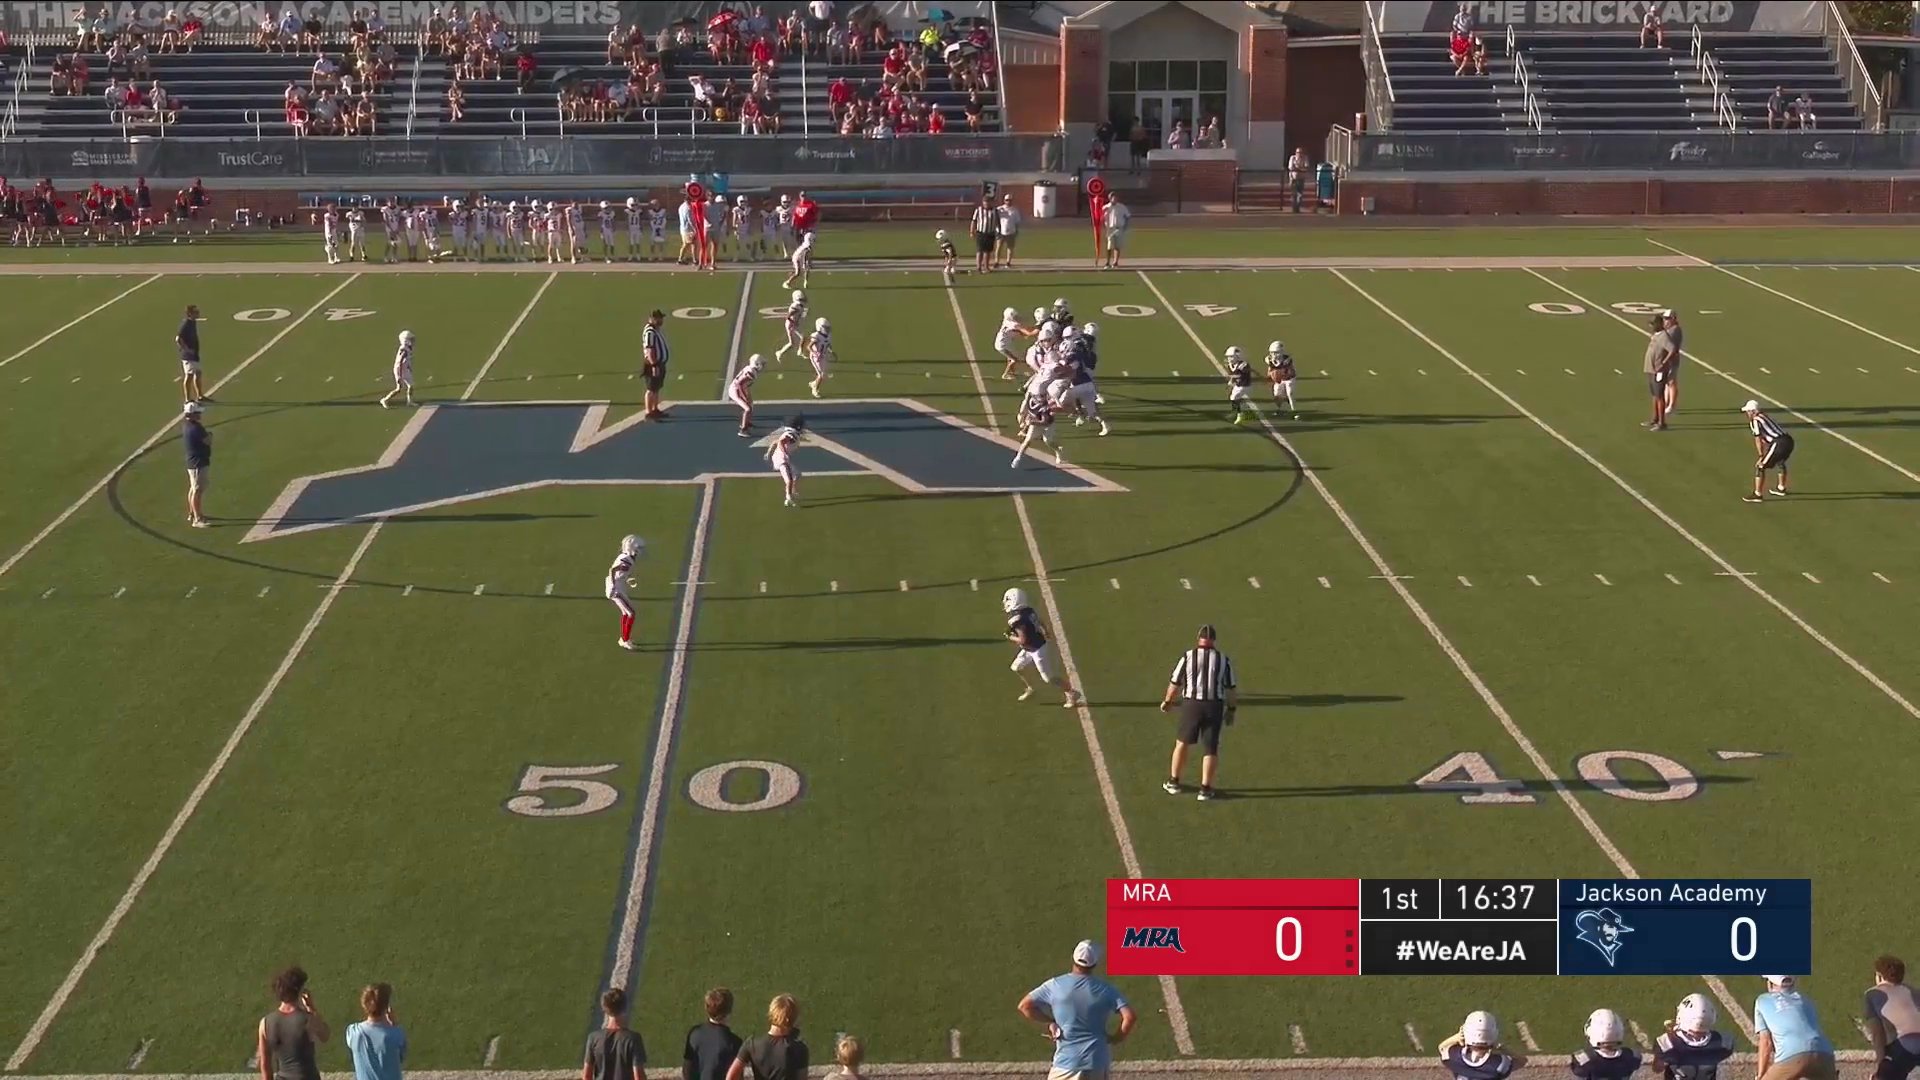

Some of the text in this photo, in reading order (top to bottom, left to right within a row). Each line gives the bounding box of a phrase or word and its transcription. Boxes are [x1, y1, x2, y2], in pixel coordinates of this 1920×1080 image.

[13, 1, 84, 28] THE
[1465, 1, 1734, 23] THE BRICKYARD
[217, 152, 283, 166] TrustCare
[985, 183, 996, 198] 3
